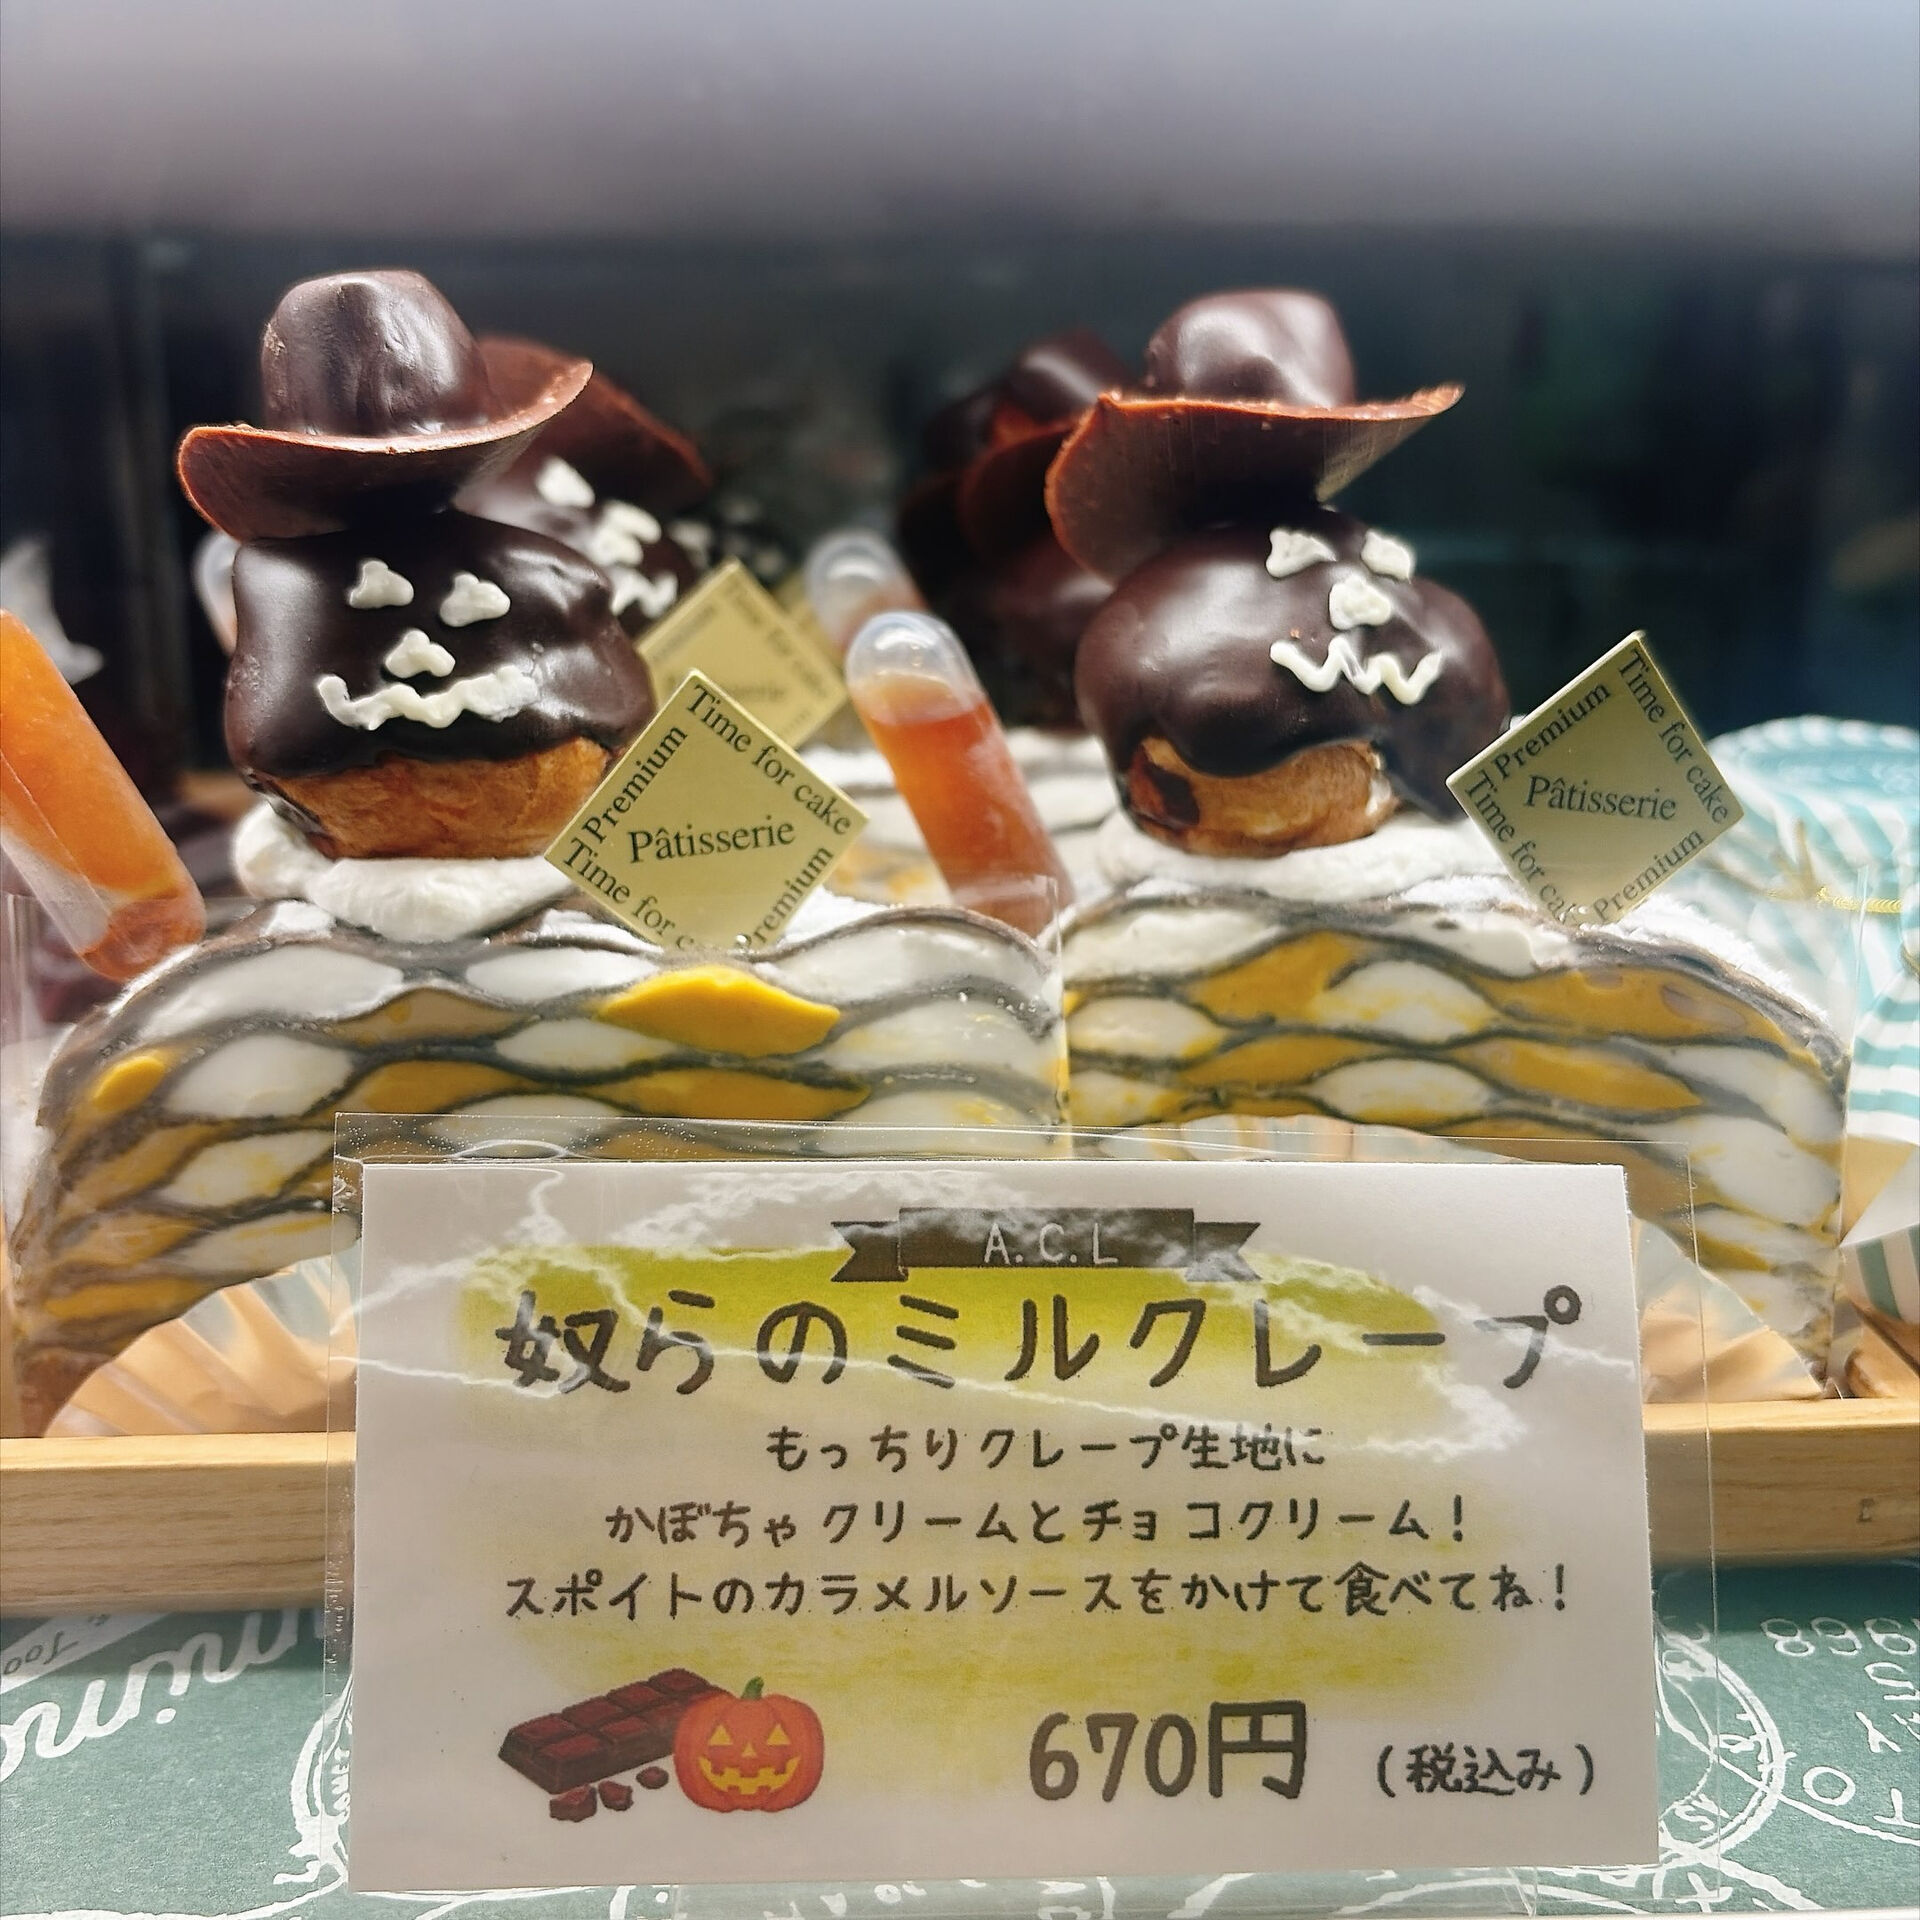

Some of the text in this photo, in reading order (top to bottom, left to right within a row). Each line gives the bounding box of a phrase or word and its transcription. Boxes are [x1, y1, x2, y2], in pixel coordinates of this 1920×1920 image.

[687, 685, 752, 753] Time
[752, 746, 796, 787] for
[793, 784, 851, 836] cake
[1490, 682, 1611, 780] Premium
[1617, 650, 1729, 825] Time for cake
[581, 724, 688, 844] Premium
[1464, 770, 1516, 844] Time
[1508, 840, 1546, 884] for
[1524, 774, 1677, 822] Pâtisserie
[563, 837, 677, 934] Time for
[629, 814, 797, 863] Pâtisserie
[1592, 829, 1705, 922] Premium
[984, 1222, 1119, 1265] A.C.L
[495, 1285, 1583, 1394] 奴らのミルクレープ
[766, 1424, 1326, 1473] もっちりクレープ生地に
[1029, 1701, 1307, 1802] 670円
